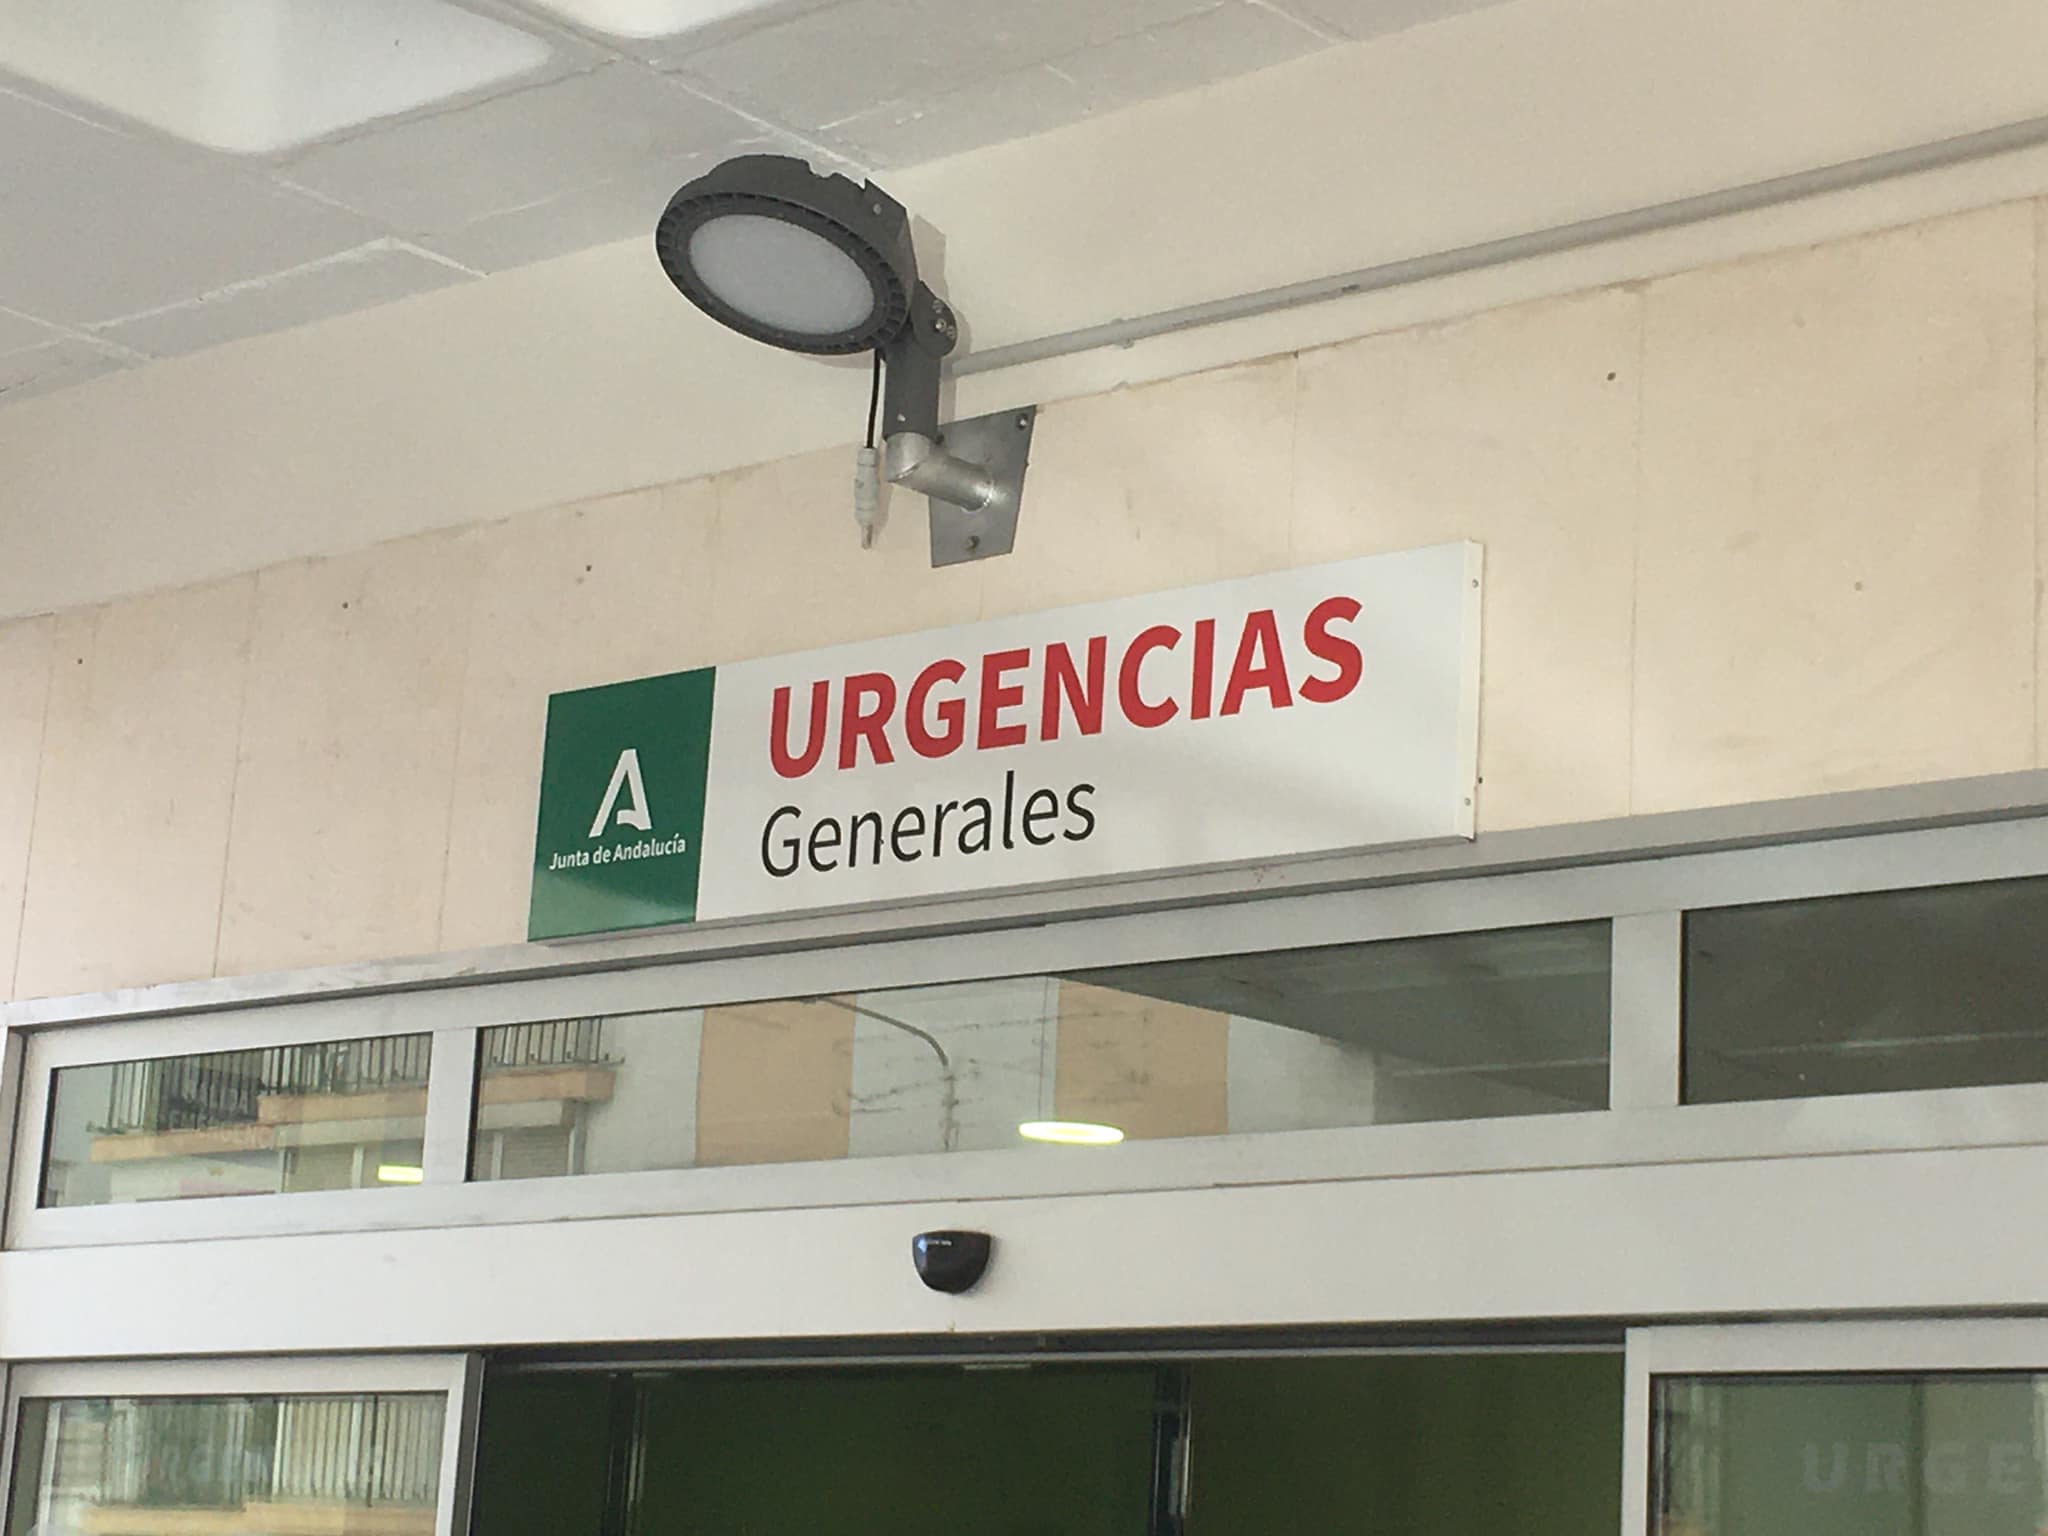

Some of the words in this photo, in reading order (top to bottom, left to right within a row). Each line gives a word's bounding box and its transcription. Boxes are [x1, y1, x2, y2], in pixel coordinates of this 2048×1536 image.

[769, 596, 1363, 778] URGENCIAS
[548, 852, 590, 870] Junta
[593, 845, 611, 864] de
[612, 833, 686, 862] Andalucía
[760, 770, 1096, 879] Generales
